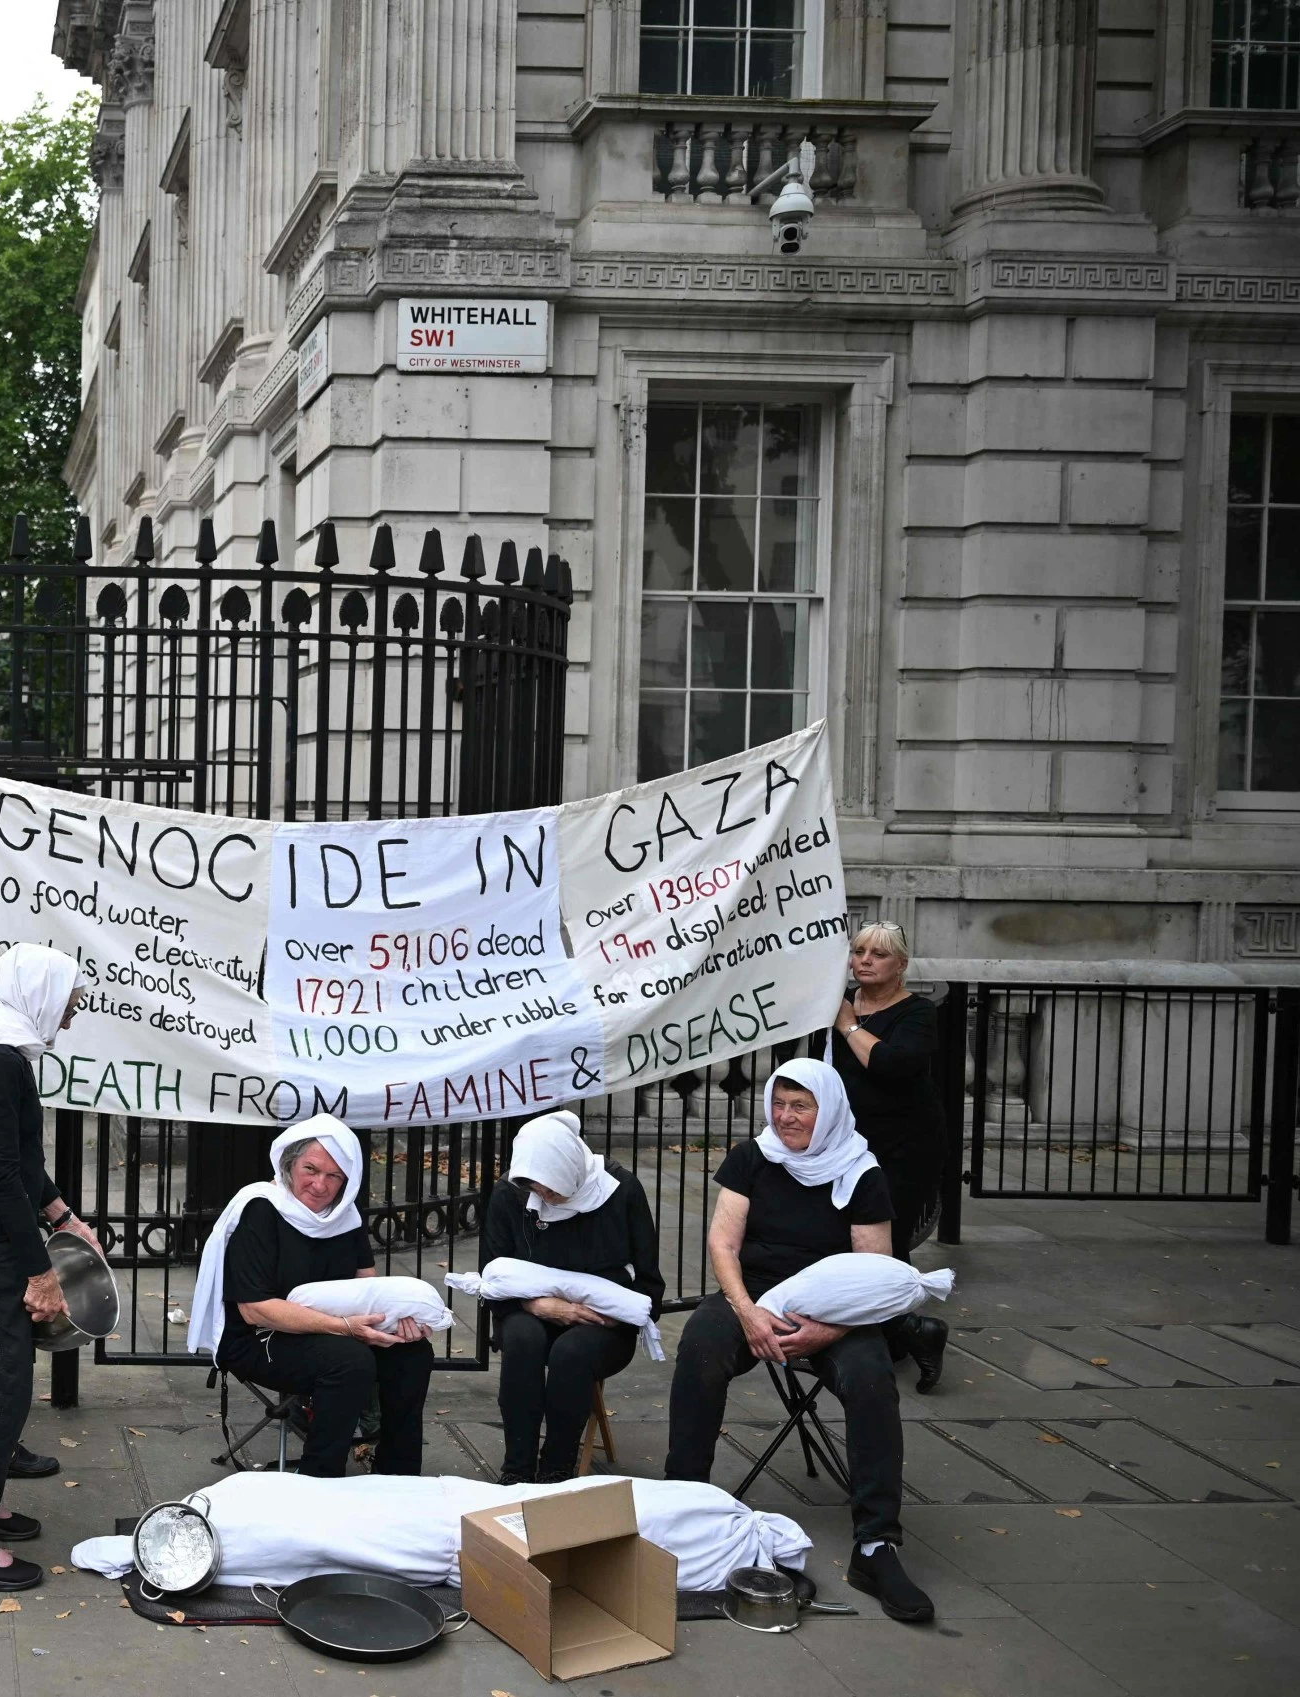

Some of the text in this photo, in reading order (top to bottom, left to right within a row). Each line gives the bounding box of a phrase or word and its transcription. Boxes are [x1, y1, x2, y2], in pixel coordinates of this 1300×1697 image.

[410, 306, 537, 325] WHITEHALL
[410, 329, 454, 347] SW1
[409, 358, 521, 368] CITY OF WESTMINSTER
[476, 825, 546, 895] IN
[604, 759, 799, 872] GAZA
[30, 880, 103, 925] food,
[108, 905, 189, 942] water,
[585, 893, 635, 928] over
[599, 933, 656, 964] 1.9m
[775, 869, 832, 917] plan
[285, 920, 544, 972] over 59,106 dead
[594, 984, 628, 1007] for
[641, 933, 782, 998] conctration
[105, 961, 196, 1004] schools,
[402, 965, 547, 1006] children
[38, 982, 789, 1121] DEATH FROM FAMINE & DISEASE
[150, 1005, 257, 1050] destroyed
[289, 996, 577, 1061] 11,000 under rubble
